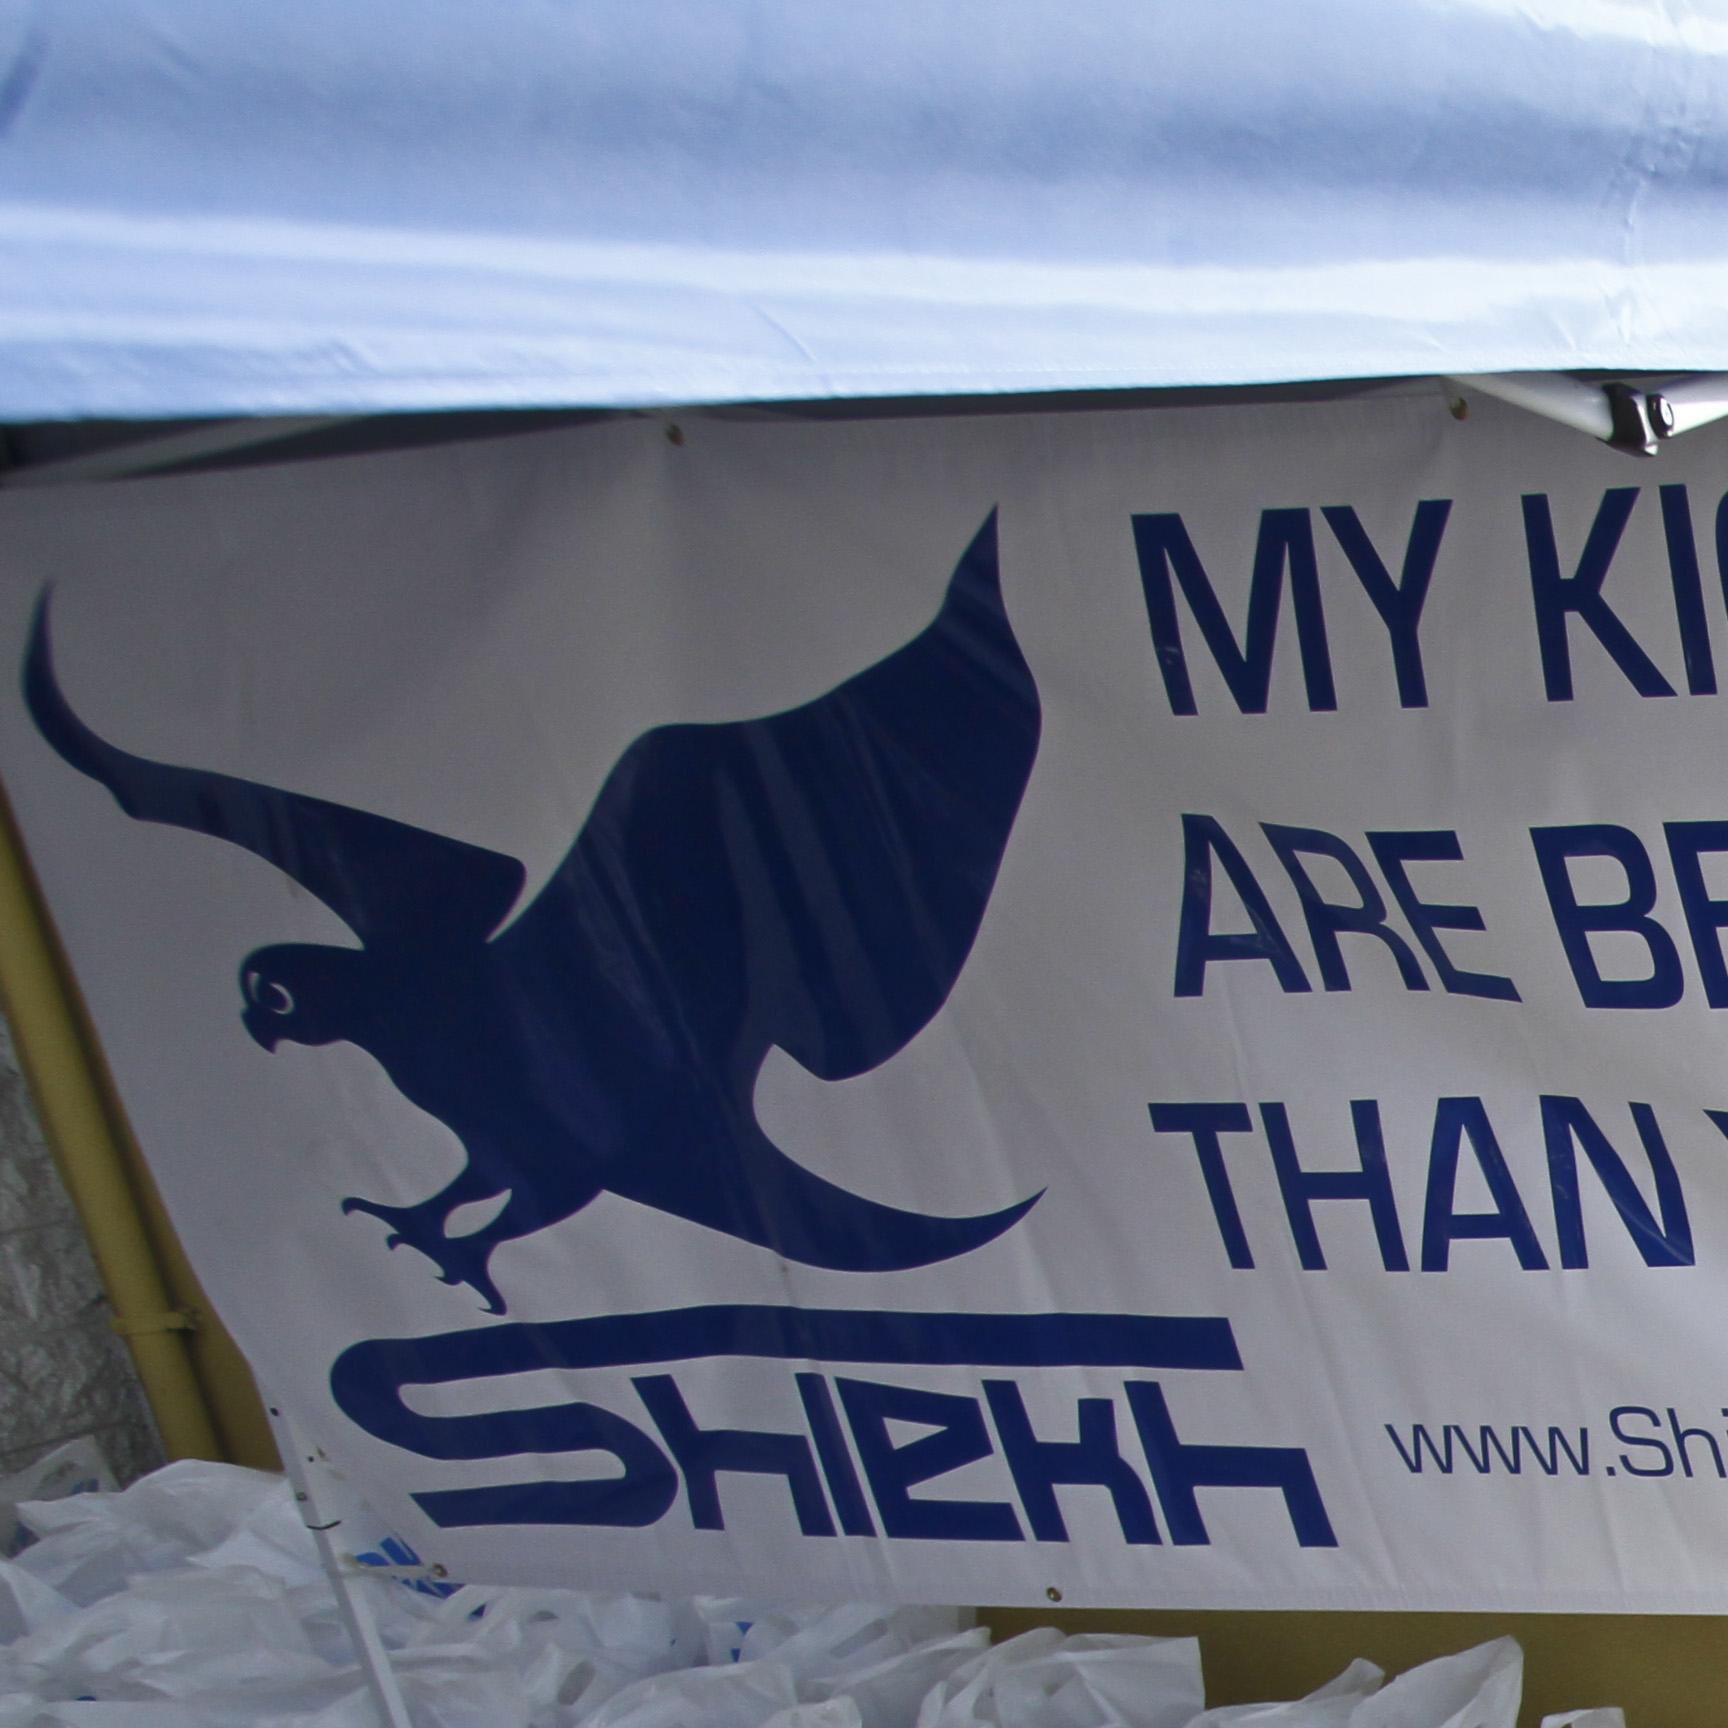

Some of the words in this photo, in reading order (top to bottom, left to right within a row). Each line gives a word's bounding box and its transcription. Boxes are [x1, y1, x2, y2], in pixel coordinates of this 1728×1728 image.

[1130, 498, 1453, 715] MY
[1174, 813, 1522, 1002] ARE
[1148, 1095, 1695, 1272] THAN
